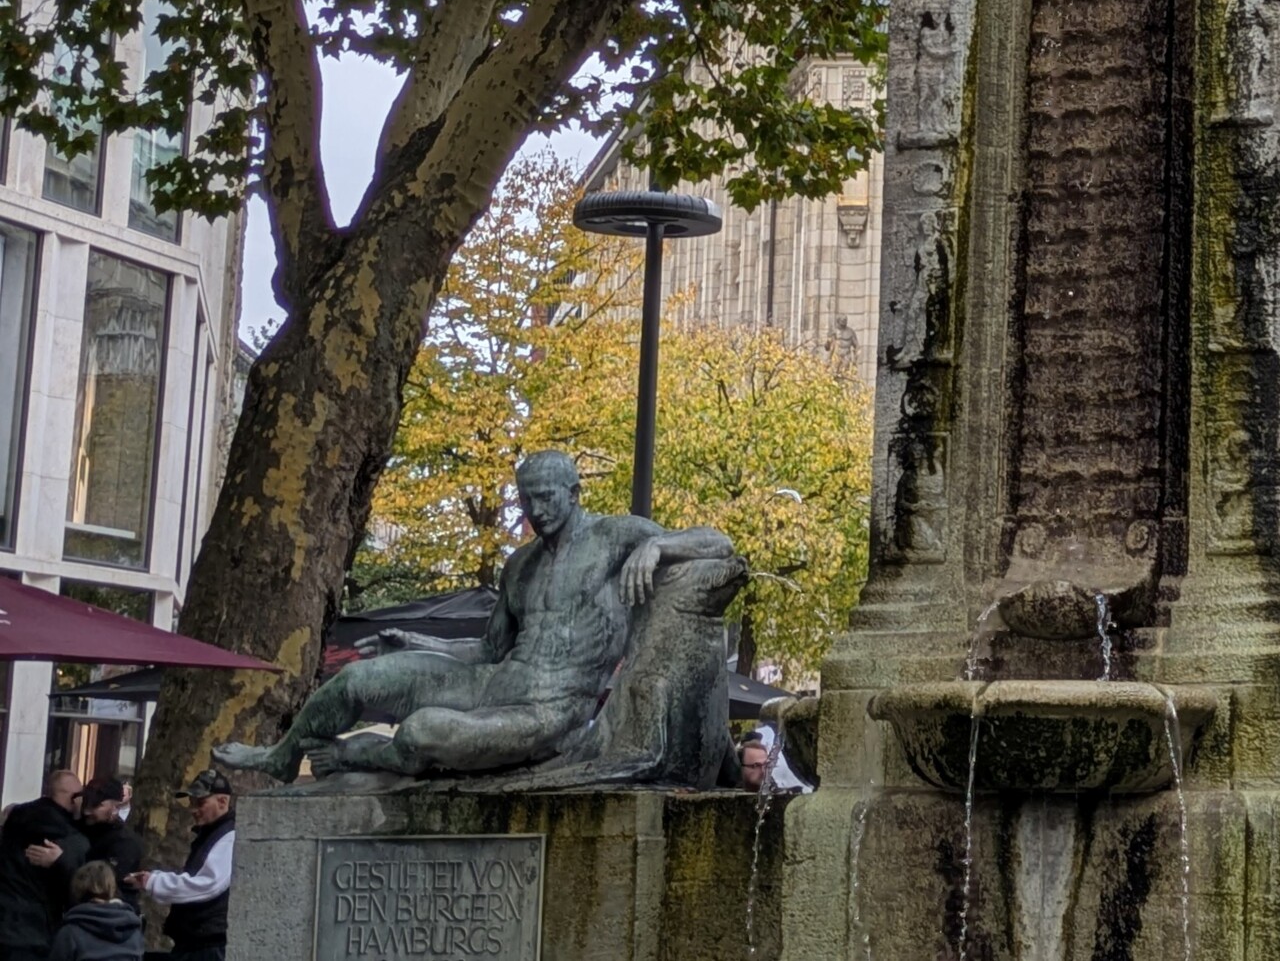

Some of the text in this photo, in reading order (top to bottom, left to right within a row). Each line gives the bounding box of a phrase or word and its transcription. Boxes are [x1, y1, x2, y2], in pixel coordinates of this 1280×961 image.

[333, 859, 524, 890] GESTIFTET VON
[334, 893, 386, 923] DEN
